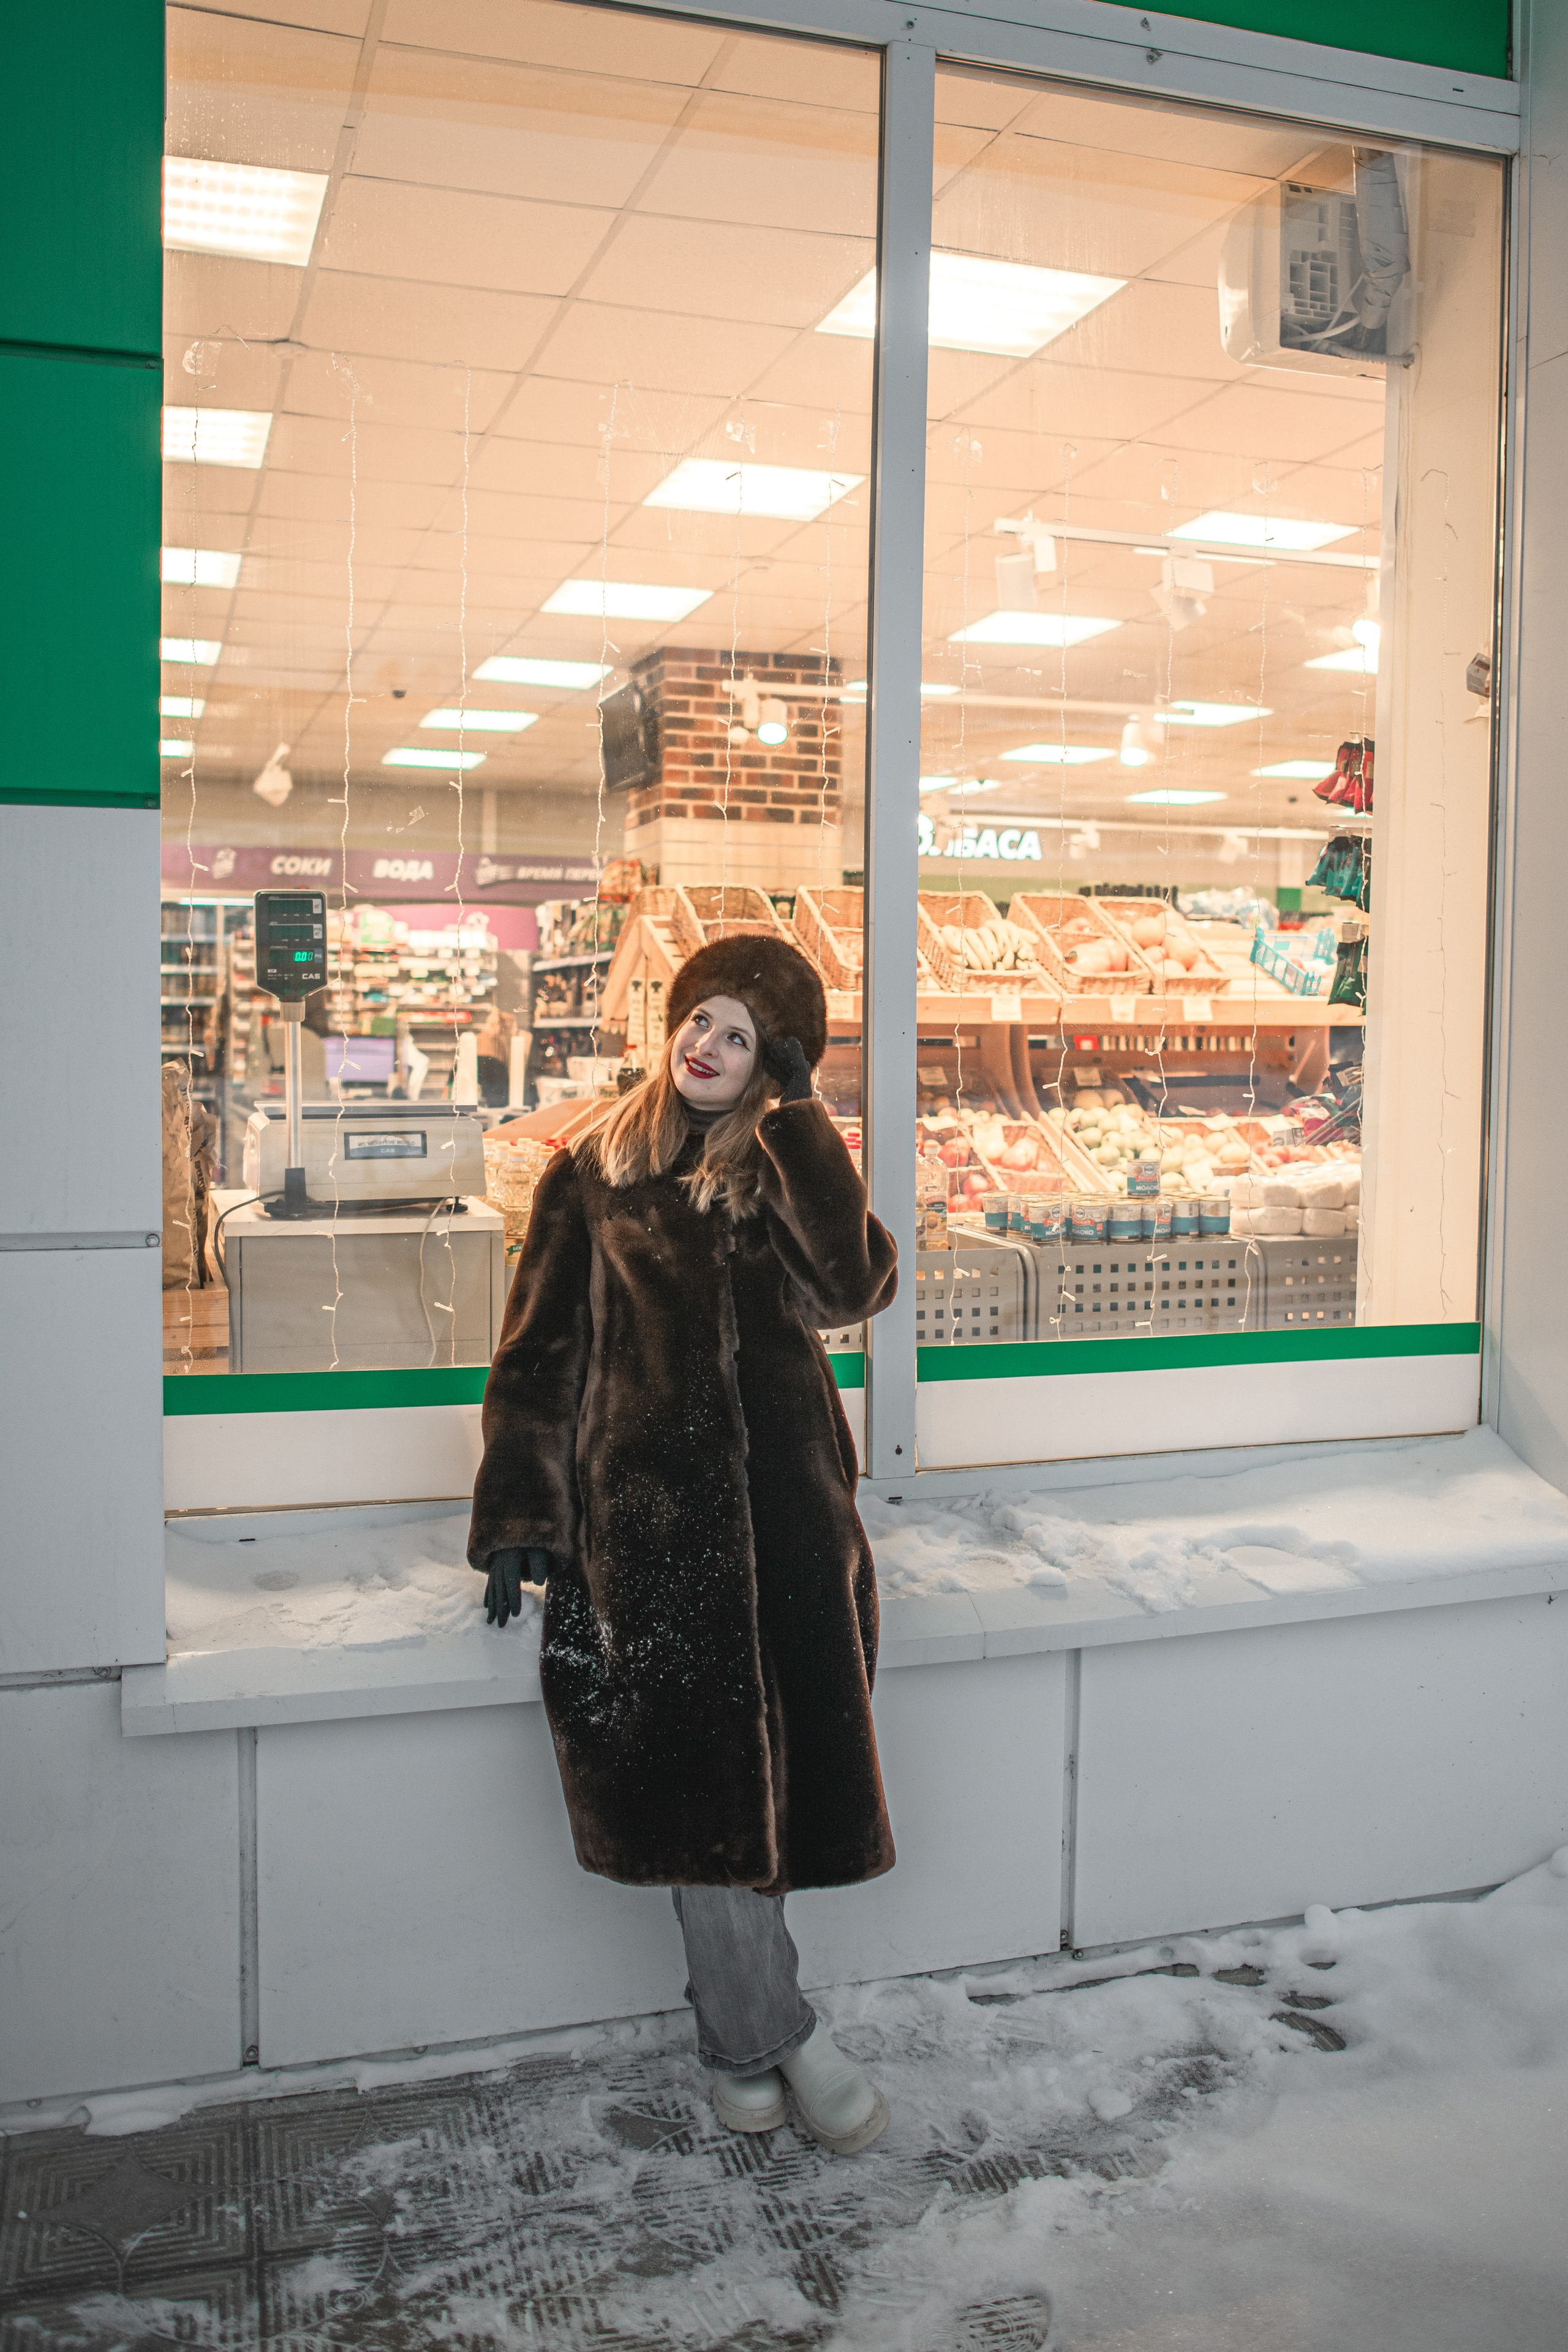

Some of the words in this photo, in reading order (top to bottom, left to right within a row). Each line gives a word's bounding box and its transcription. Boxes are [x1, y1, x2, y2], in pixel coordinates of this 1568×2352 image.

[918, 828, 1042, 861] ОБАСА
[271, 855, 332, 876] СОКИ
[372, 859, 434, 881] ВОДА
[294, 951, 314, 962] 0.00
